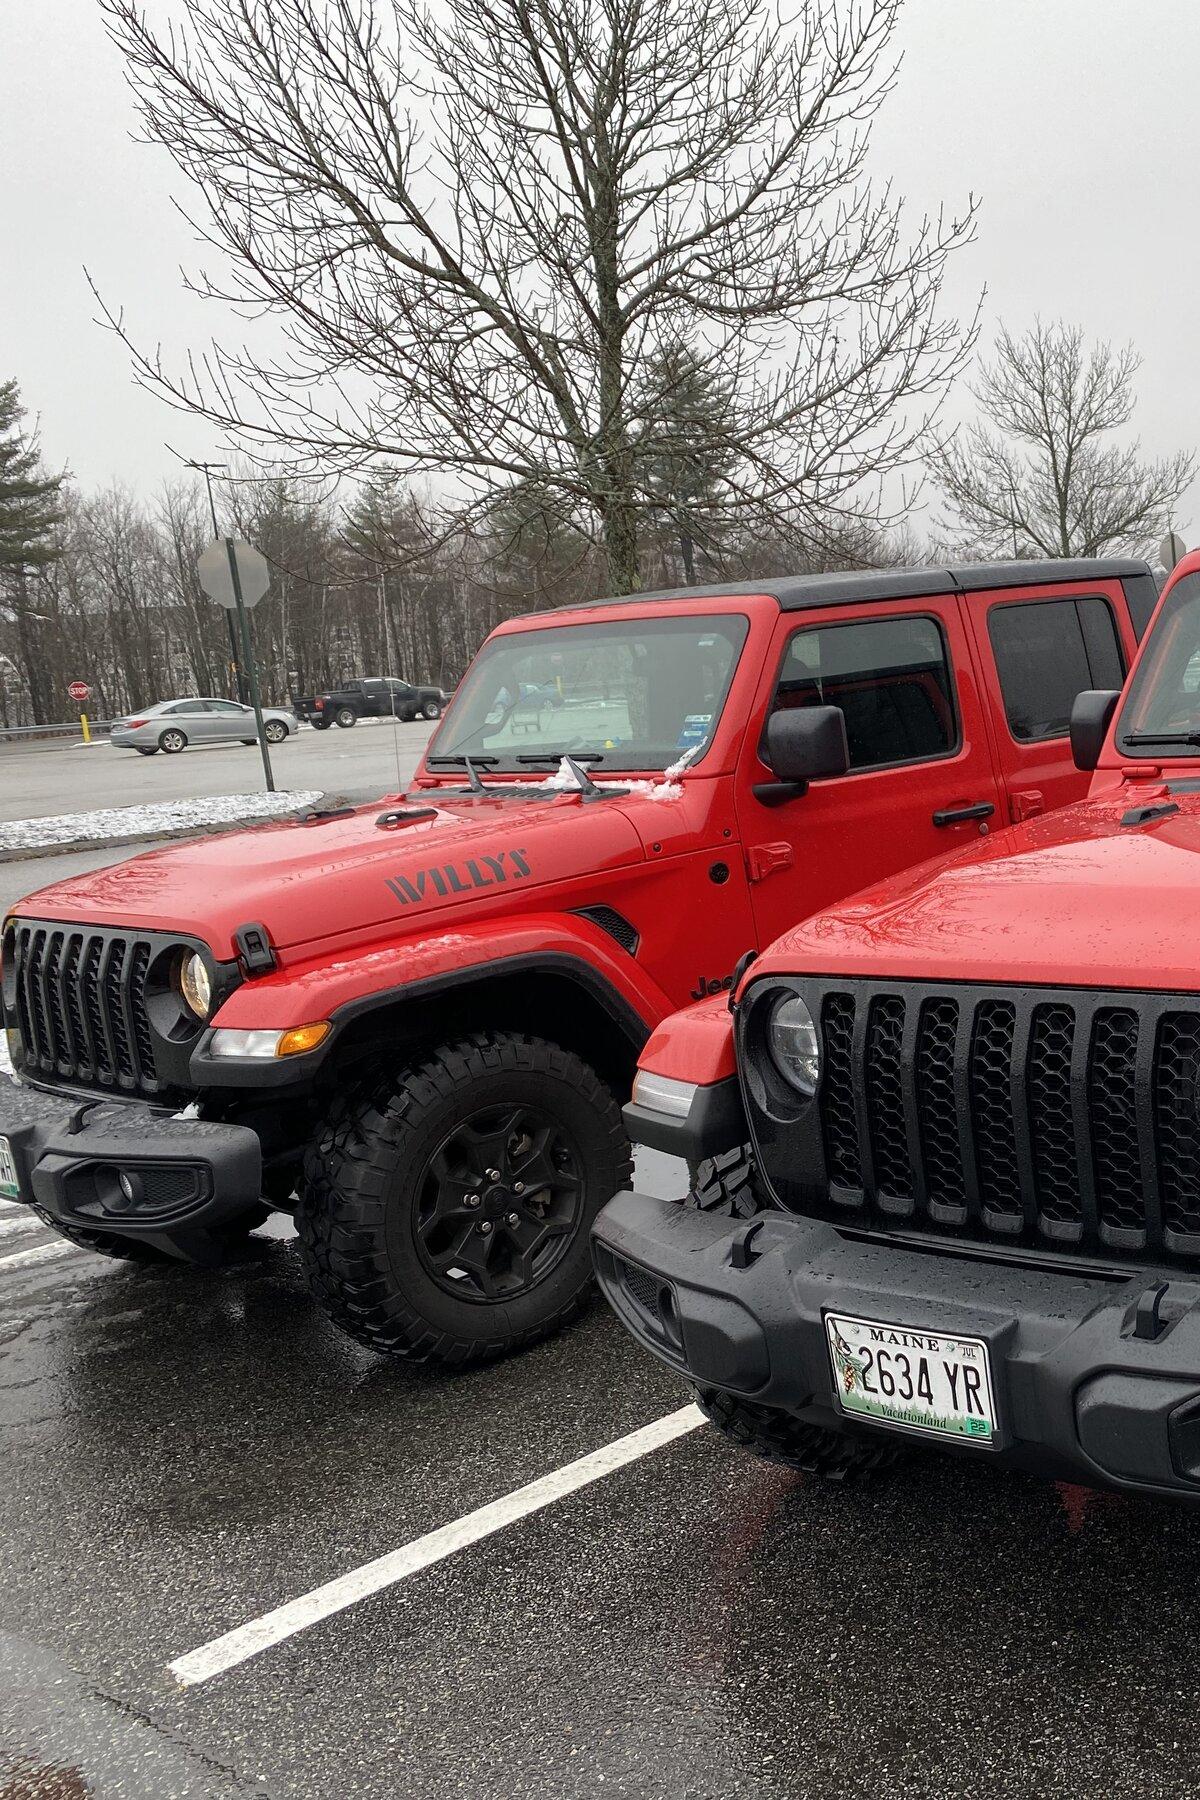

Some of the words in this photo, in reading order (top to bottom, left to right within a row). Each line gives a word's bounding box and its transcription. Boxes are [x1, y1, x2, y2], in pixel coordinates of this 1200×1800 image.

[70, 687, 88, 695] STOP
[384, 848, 531, 904] WILLYS
[690, 976, 735, 1000] Jee
[869, 1328, 940, 1352] MAINE
[963, 1347, 976, 1358] JUL
[858, 1346, 934, 1406] 2634
[942, 1360, 985, 1416] YR
[881, 1404, 947, 1429] Vacationland
[970, 1421, 987, 1434] 22
